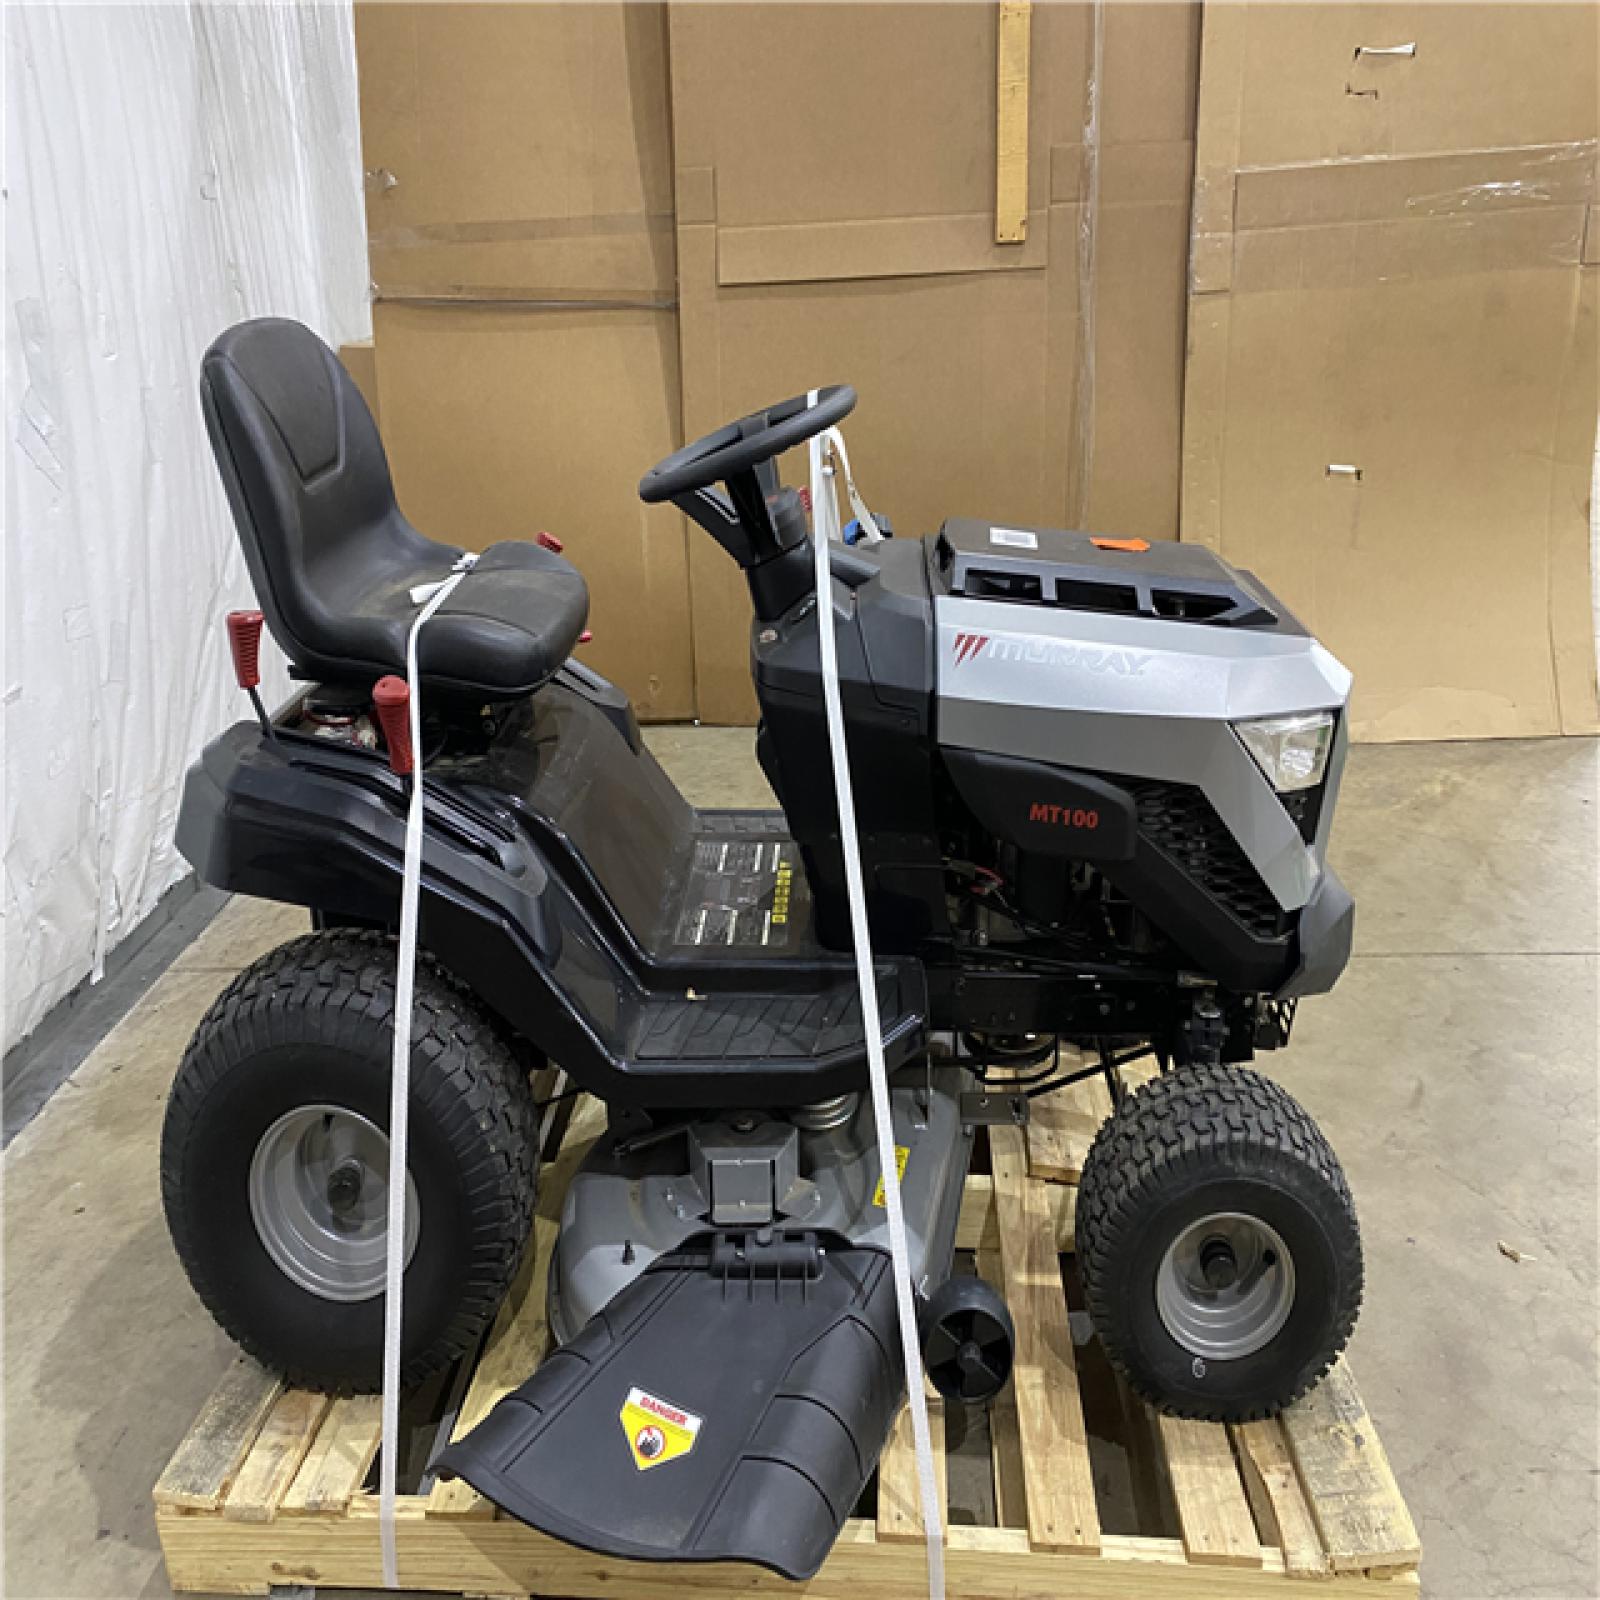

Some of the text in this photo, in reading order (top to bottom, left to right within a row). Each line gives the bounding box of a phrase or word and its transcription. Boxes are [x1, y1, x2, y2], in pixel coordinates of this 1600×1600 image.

[988, 639, 1151, 677] MURRAY
[1029, 803, 1099, 828] MT100
[640, 1396, 688, 1425] DANGER
